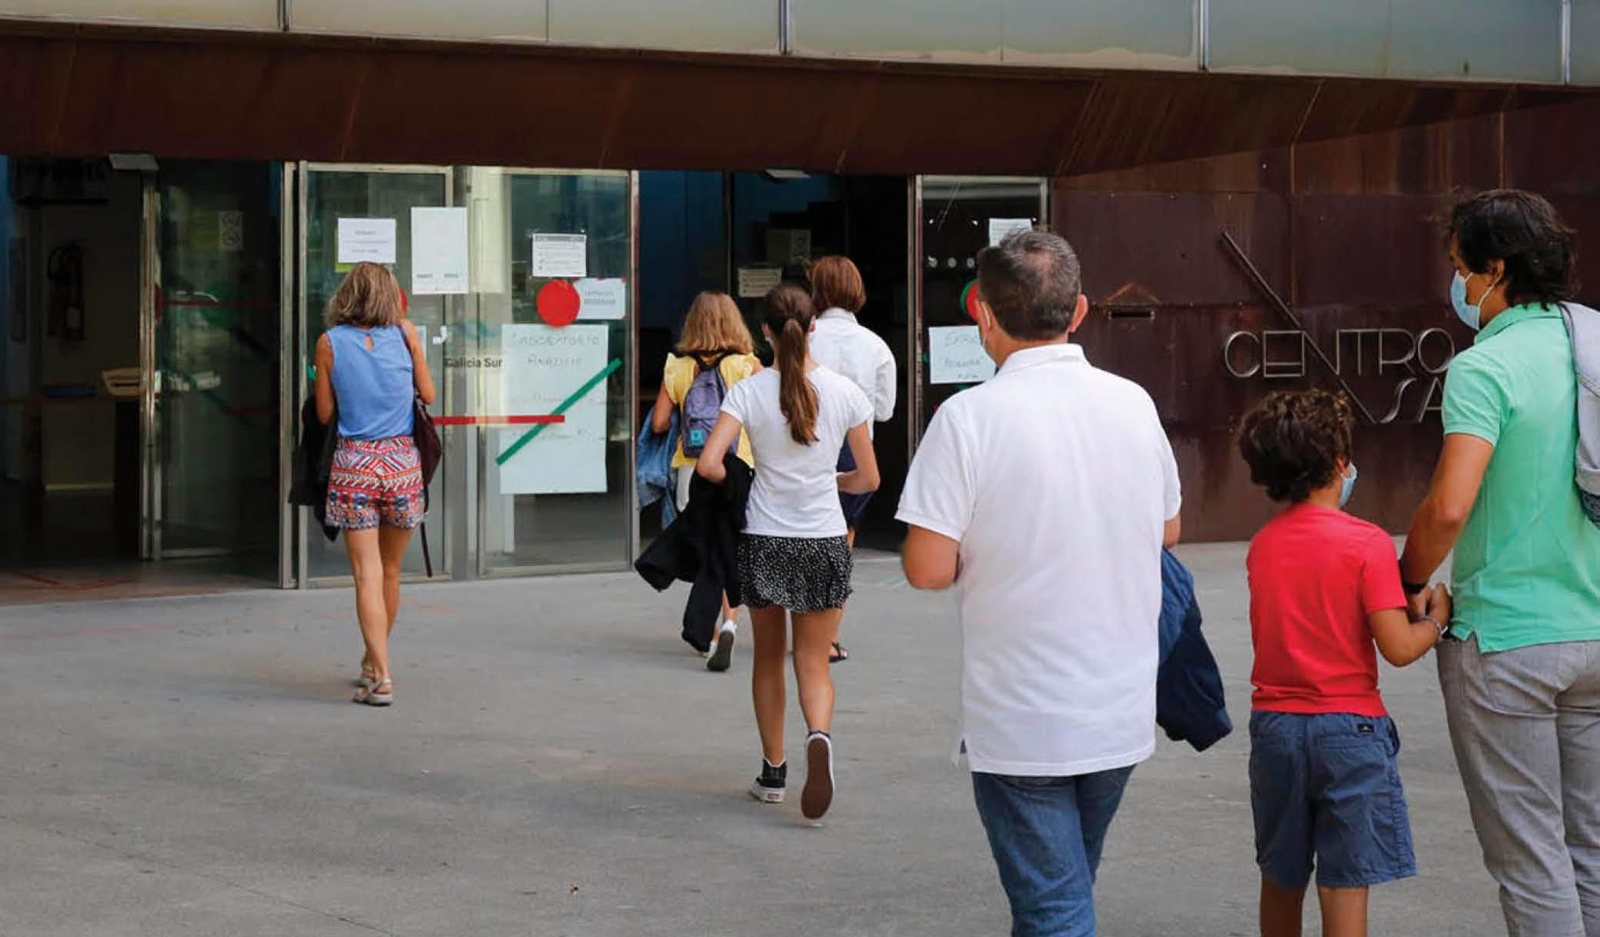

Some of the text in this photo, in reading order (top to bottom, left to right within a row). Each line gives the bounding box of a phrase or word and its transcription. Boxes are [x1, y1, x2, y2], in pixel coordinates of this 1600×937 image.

[444, 356, 504, 369] Galicia Sur
[1223, 327, 1455, 379] CENTRO
[1379, 376, 1445, 424] SA
